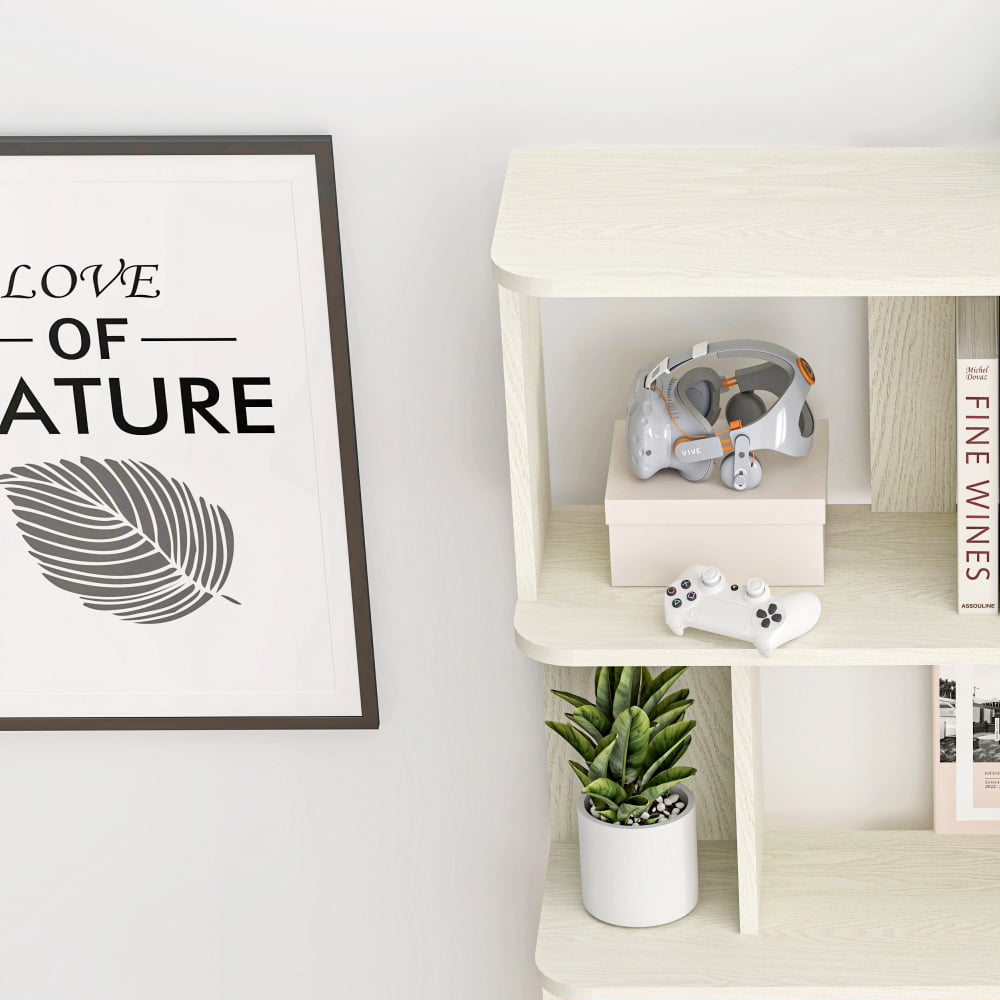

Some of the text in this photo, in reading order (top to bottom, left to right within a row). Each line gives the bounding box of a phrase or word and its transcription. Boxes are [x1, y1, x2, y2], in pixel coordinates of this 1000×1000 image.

[1, 258, 161, 299] LOVE
[48, 317, 128, 360] OF
[681, 447, 702, 456] VIVE
[965, 396, 991, 580] FINE WINES
